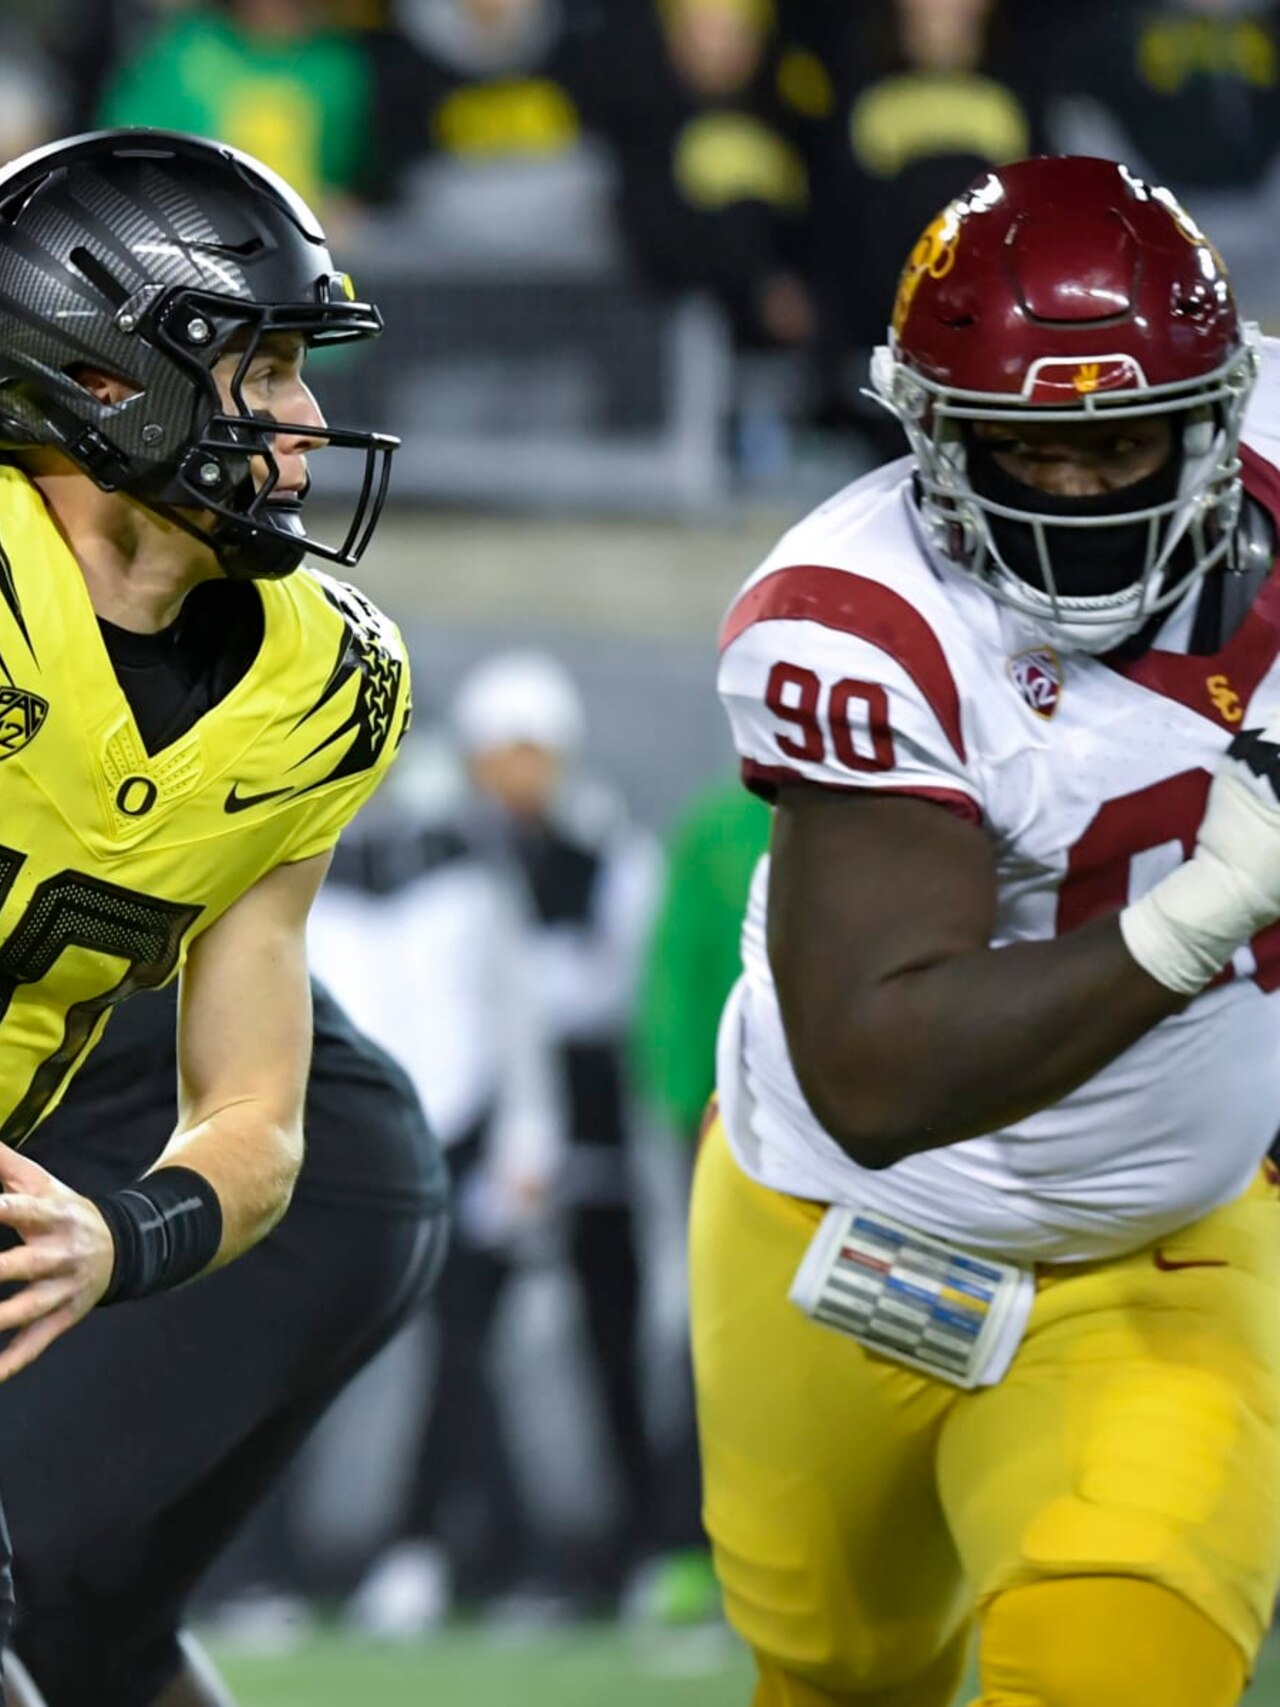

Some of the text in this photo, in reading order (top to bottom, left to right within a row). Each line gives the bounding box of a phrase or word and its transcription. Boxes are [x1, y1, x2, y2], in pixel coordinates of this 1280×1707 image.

[765, 660, 896, 773] 90
[1206, 674, 1243, 722] SC
[116, 776, 158, 817] O
